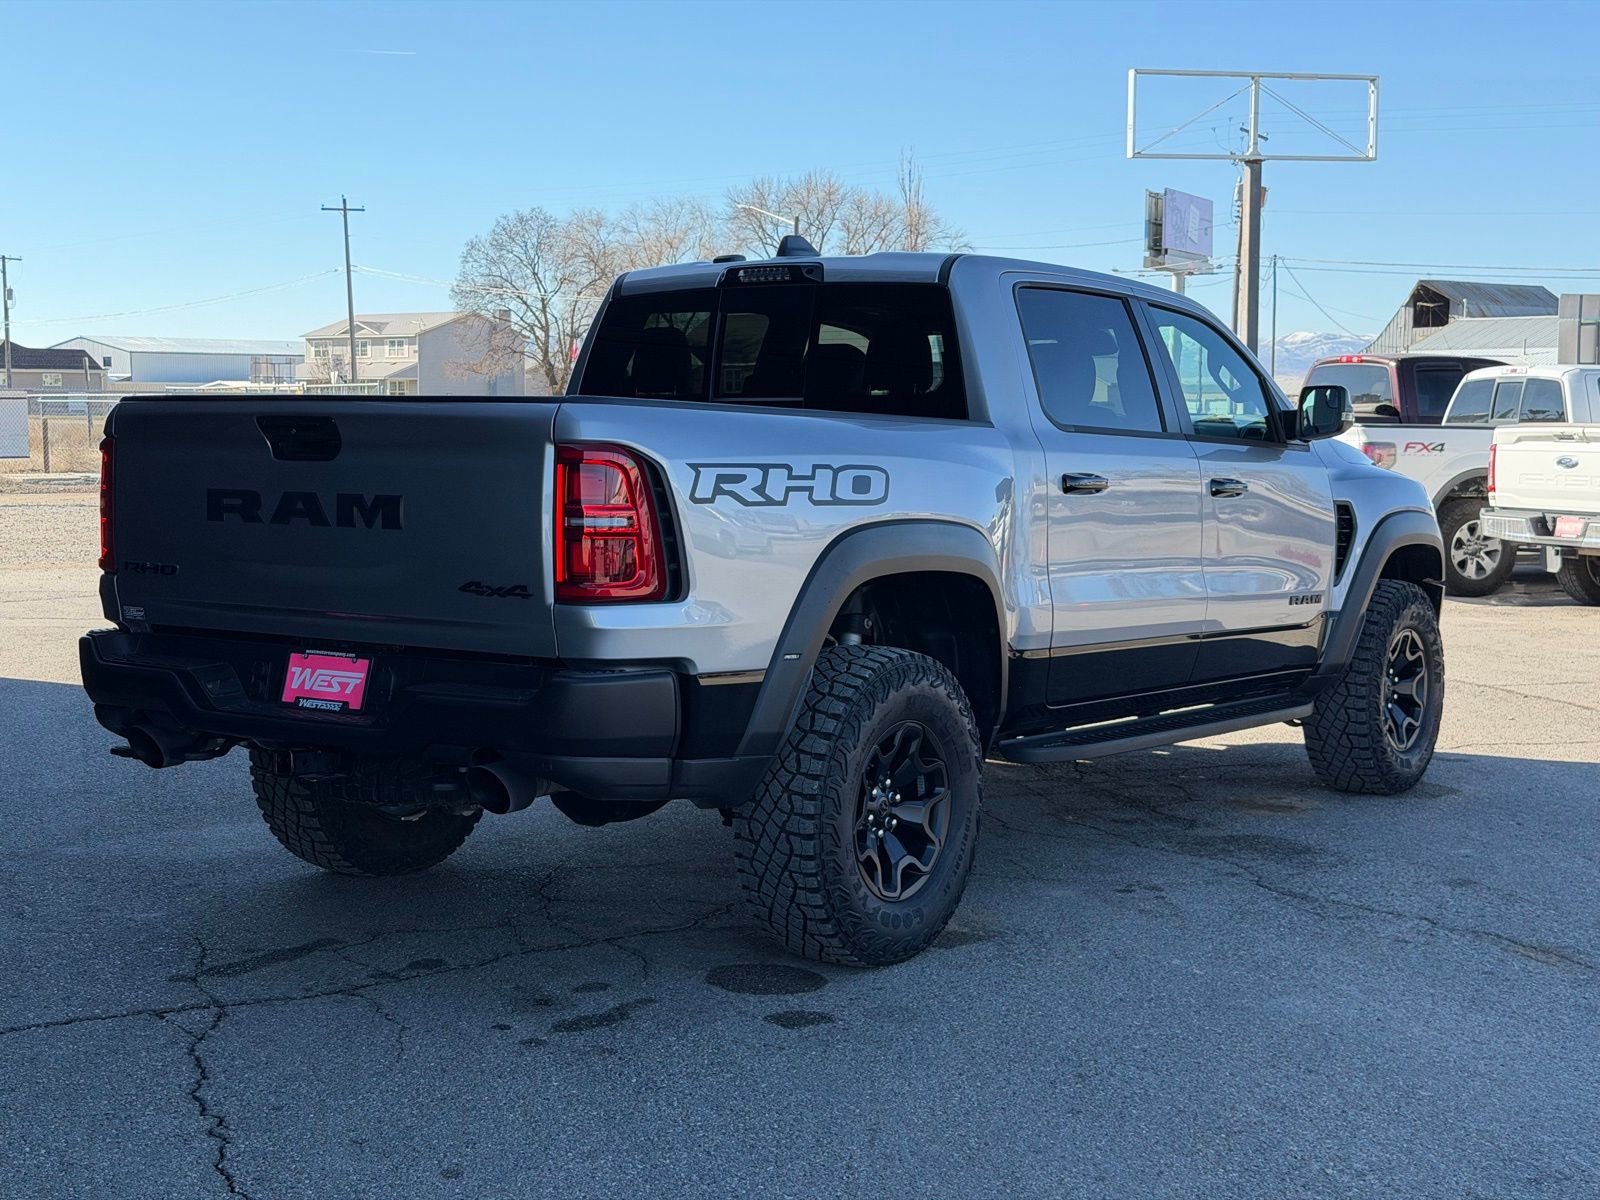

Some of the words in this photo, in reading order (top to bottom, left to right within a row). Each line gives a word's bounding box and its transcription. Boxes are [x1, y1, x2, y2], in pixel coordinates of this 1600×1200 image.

[1404, 441, 1446, 454] FX4
[685, 463, 890, 506] RHO
[206, 488, 404, 530] RAM
[1289, 594, 1322, 606] RAM
[291, 667, 365, 694] WEST
